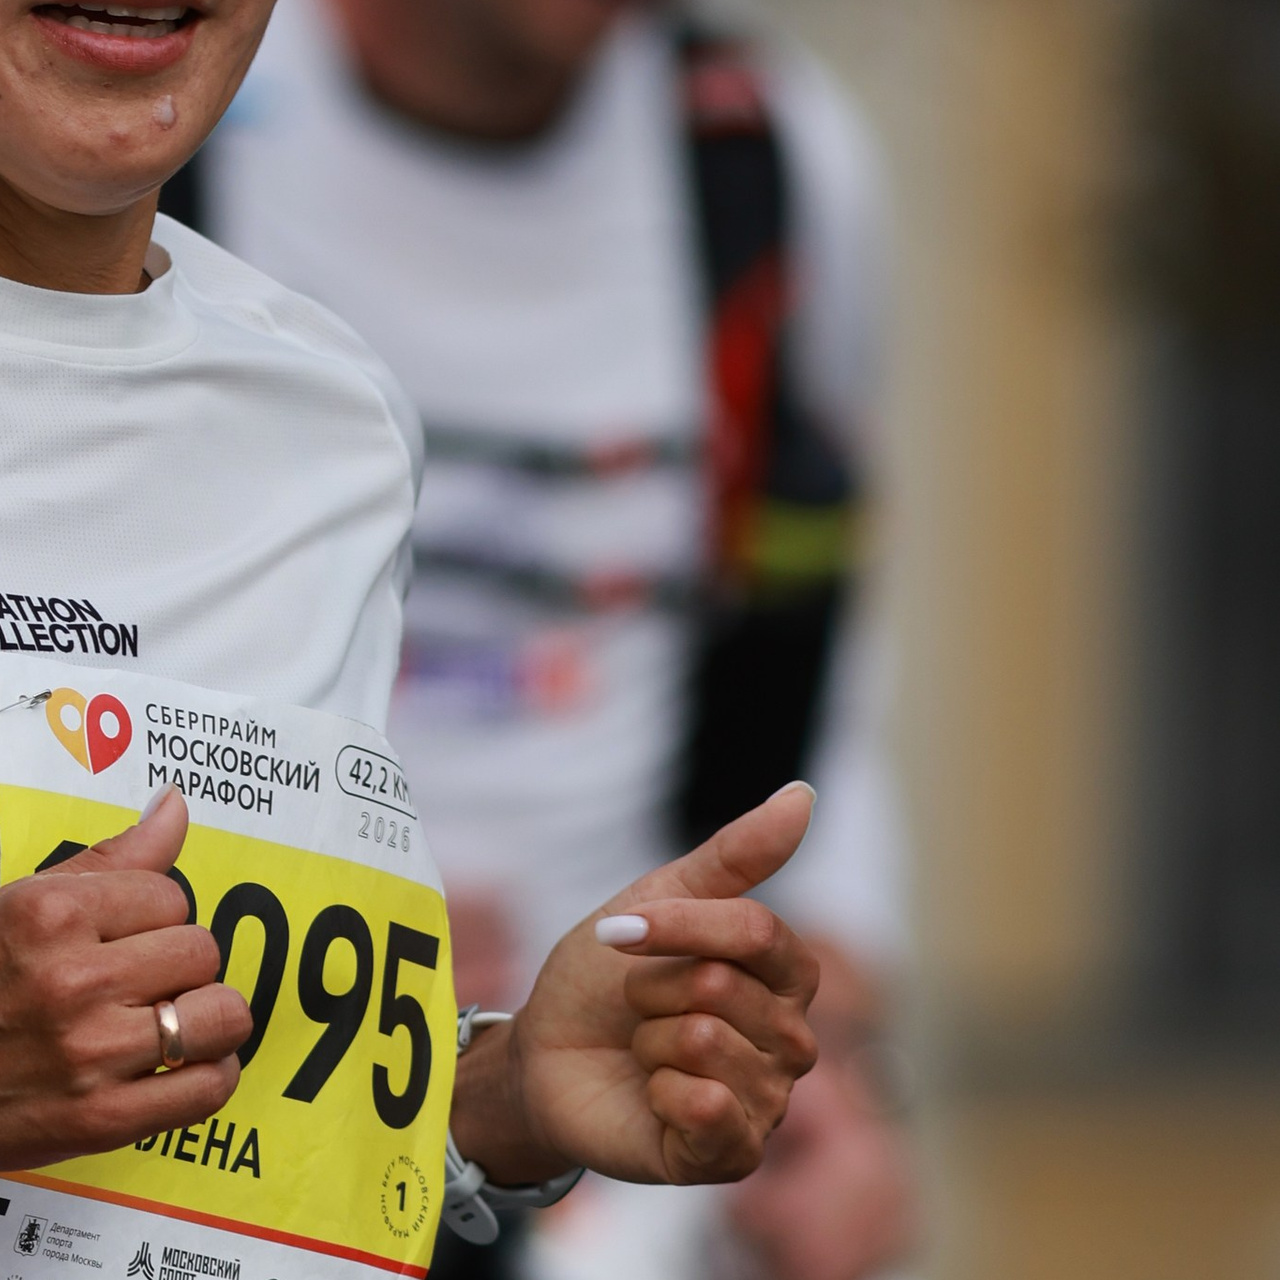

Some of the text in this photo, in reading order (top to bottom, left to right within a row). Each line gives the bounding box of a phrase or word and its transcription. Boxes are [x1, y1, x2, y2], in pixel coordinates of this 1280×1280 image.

[145, 703, 276, 749] СБЕРПРАЙМ
[147, 729, 320, 793] МОСКОВСКИЙ
[349, 757, 388, 795] 42,2
[148, 762, 273, 816] МАРАФОН
[357, 811, 410, 853] 2026
[134, 1117, 261, 1179] ЛЕНА
[395, 1180, 406, 1212] 1
[46, 1235, 73, 1249] спорта
[49, 1222, 101, 1241] Департамент
[42, 1248, 103, 1269] города Москвы
